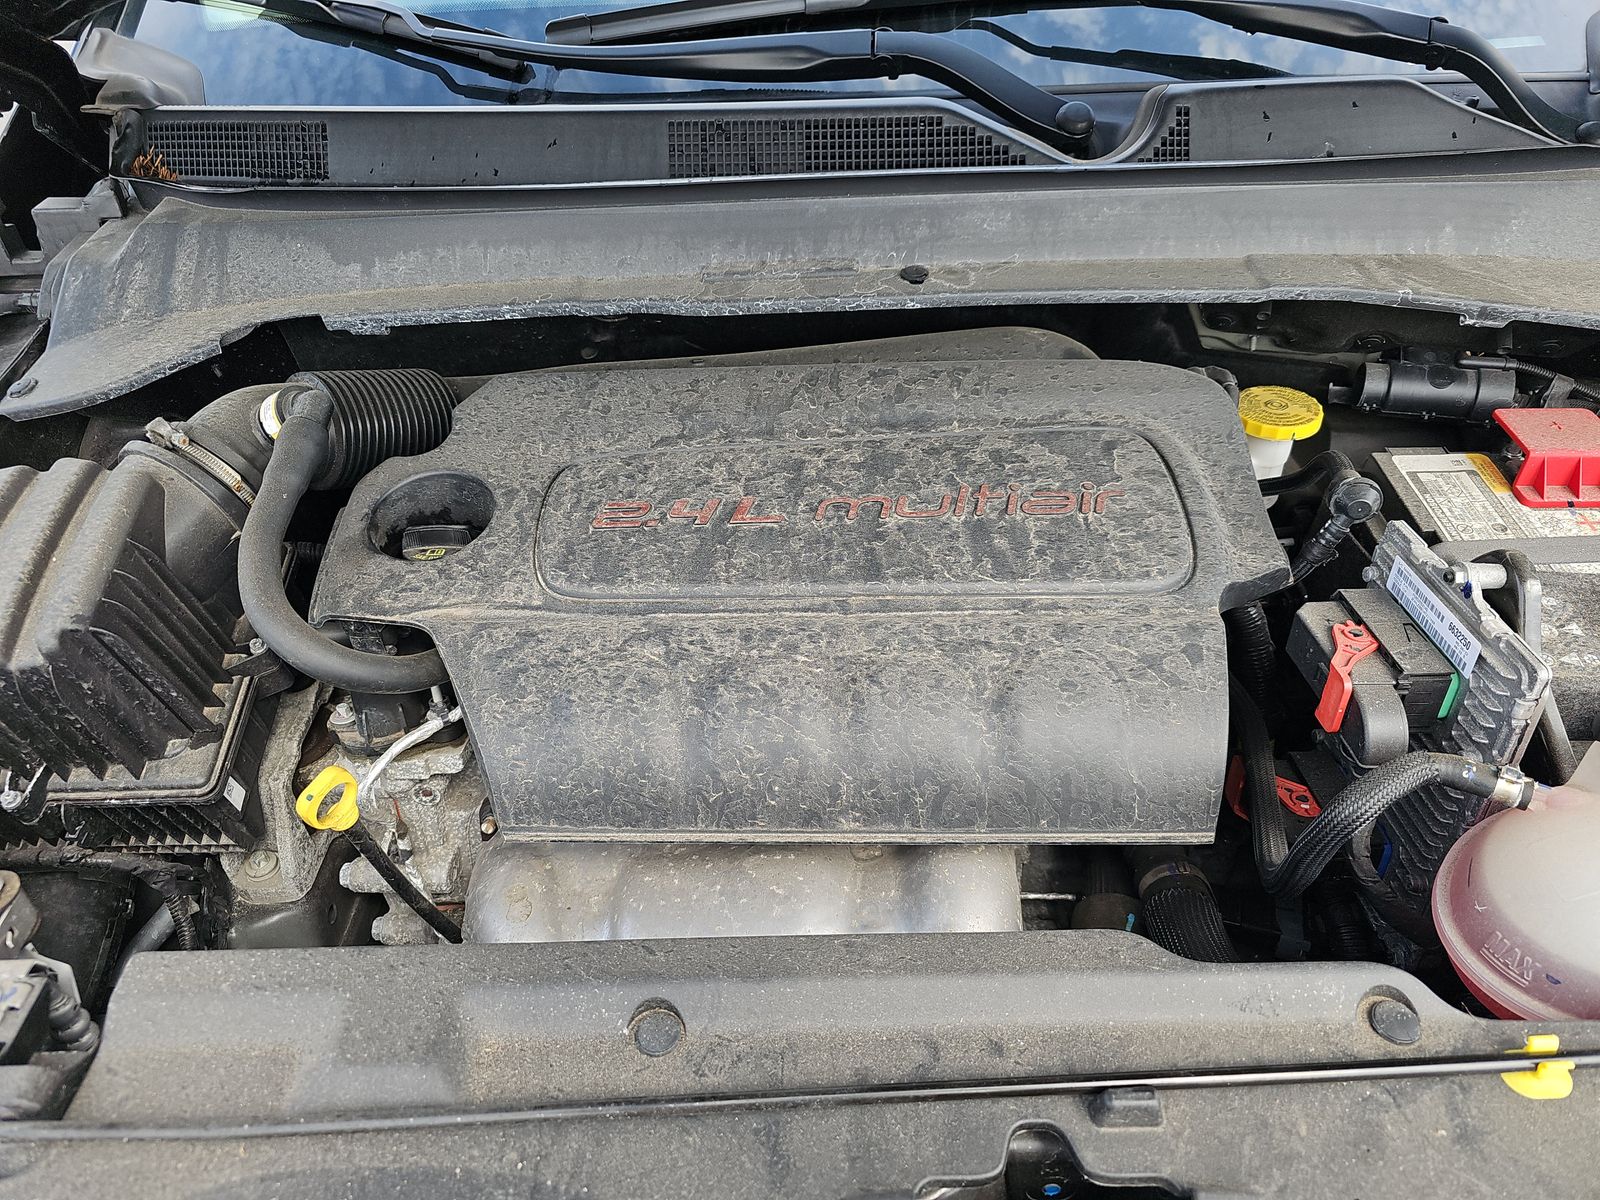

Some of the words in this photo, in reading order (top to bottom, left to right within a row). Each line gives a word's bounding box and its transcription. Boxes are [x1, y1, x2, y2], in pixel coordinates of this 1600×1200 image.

[814, 482, 1126, 521] multiair
[1447, 621, 1472, 651] 6632250
[1483, 930, 1542, 981] MAX
